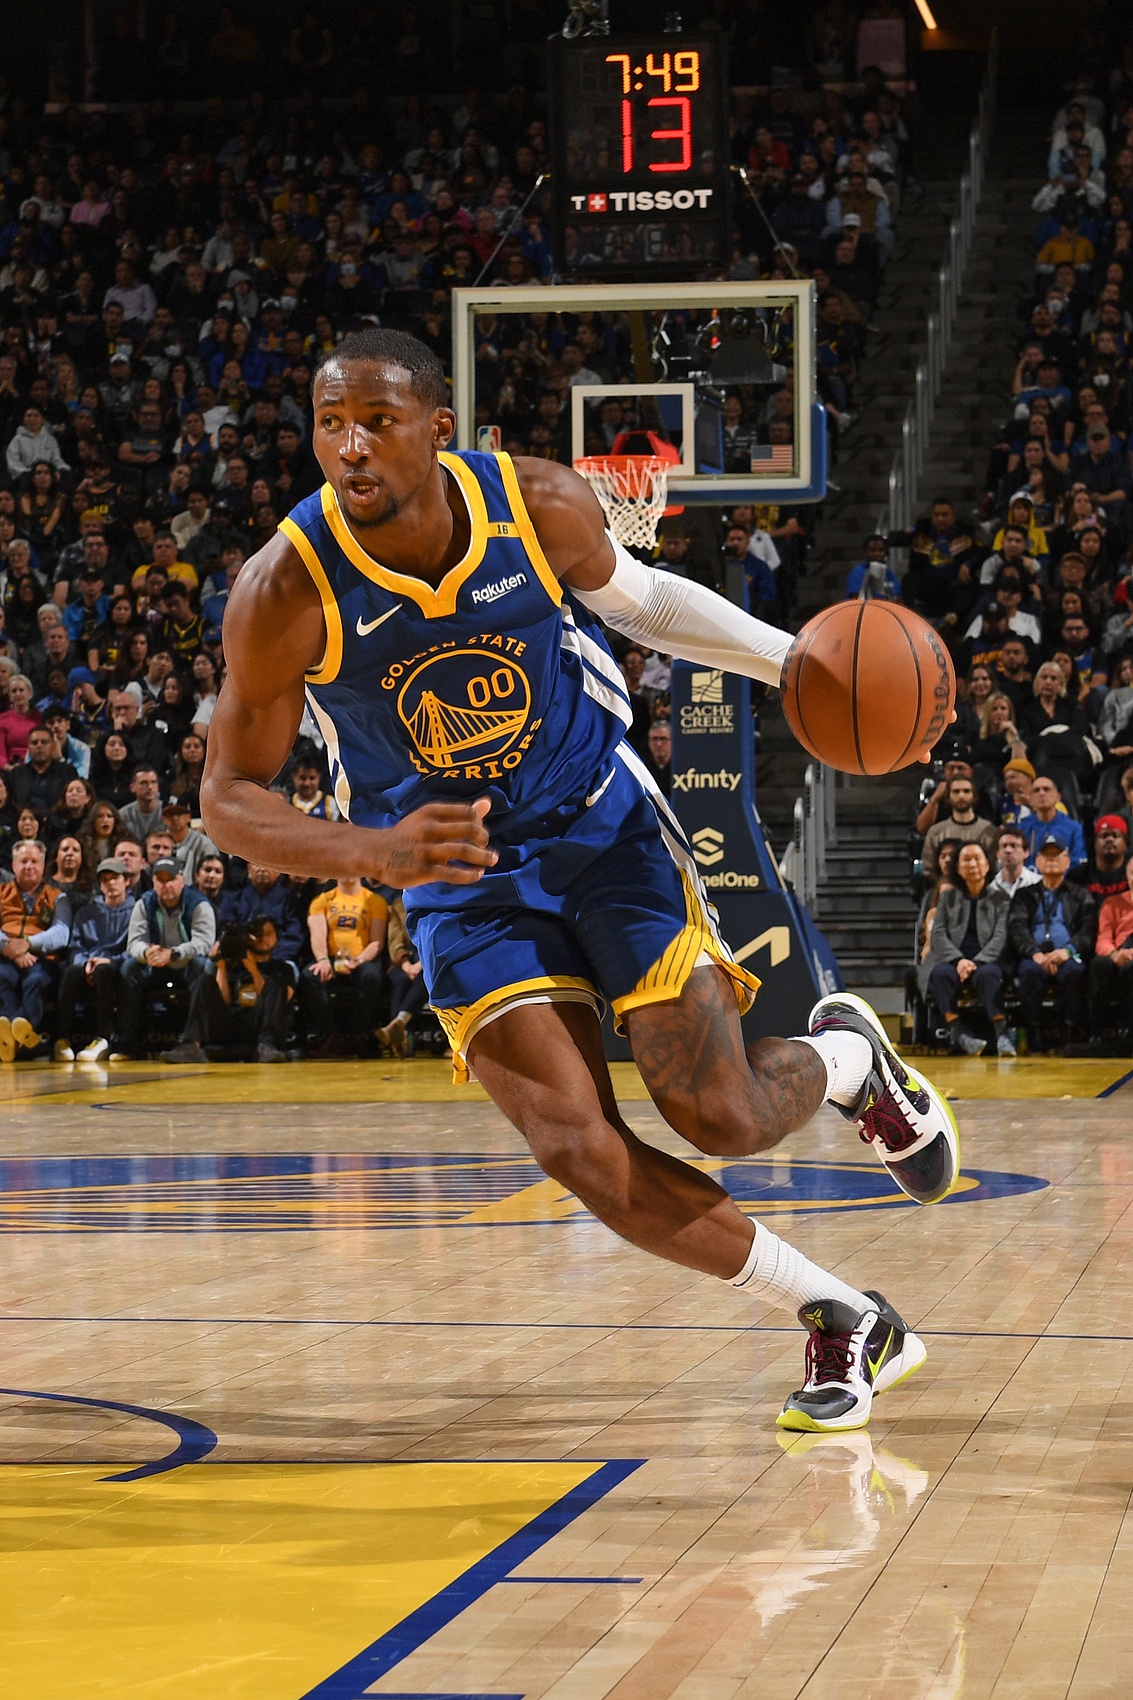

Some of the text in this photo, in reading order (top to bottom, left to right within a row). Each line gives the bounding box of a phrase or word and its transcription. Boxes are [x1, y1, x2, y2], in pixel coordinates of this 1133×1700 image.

[605, 51, 700, 94] 7:49
[621, 96, 692, 173] 13
[608, 189, 713, 212] TISSOT
[496, 524, 509, 535] 16
[471, 572, 527, 604] Rakuten
[467, 633, 528, 658] STATE
[467, 667, 515, 708] 00
[680, 704, 734, 717] CACHE
[680, 716, 734, 728] CREEK
[673, 768, 742, 791] xfinity
[700, 871, 760, 888] nelOne
